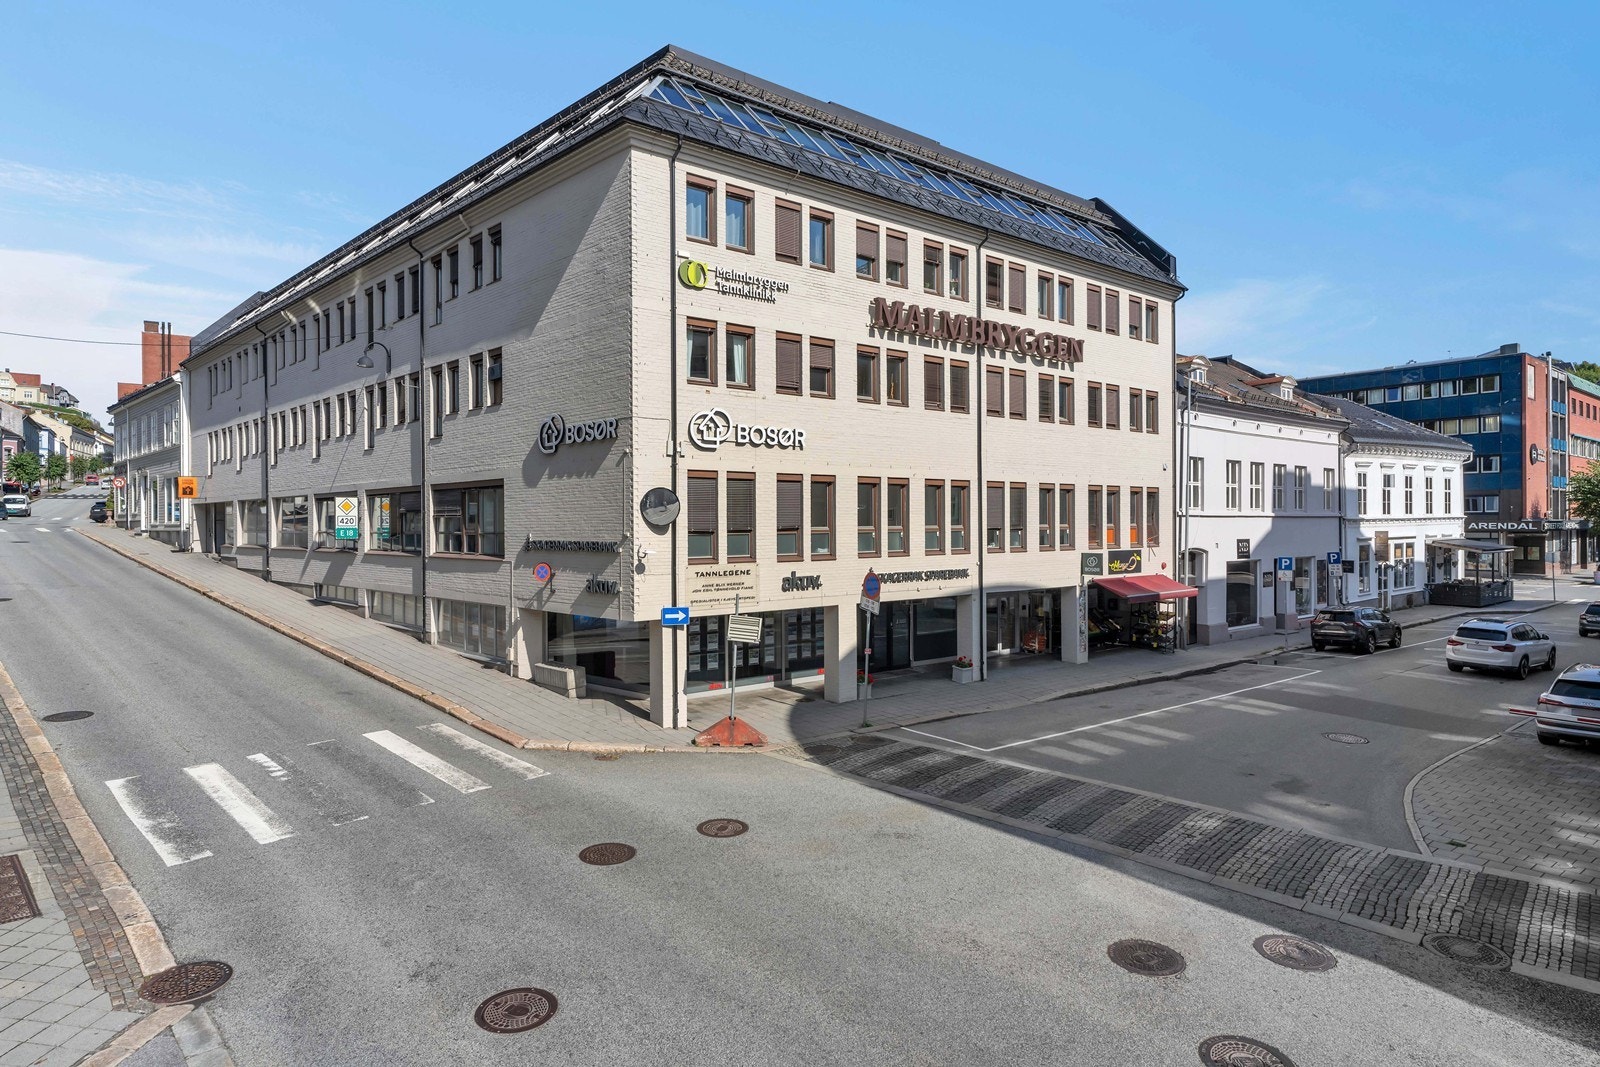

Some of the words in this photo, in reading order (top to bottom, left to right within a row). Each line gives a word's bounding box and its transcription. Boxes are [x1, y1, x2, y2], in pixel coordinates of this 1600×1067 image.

[715, 266, 789, 290] Malmbryggen
[717, 281, 777, 301] Tannklinikk
[873, 297, 1085, 362] MALMBRYGGEN
[565, 417, 617, 444] BOSØR
[737, 424, 806, 447] BOSØR
[1468, 522, 1537, 530] ARENDAL
[1281, 558, 1290, 569] P
[1330, 553, 1338, 563] P
[694, 569, 751, 577] TANNLEGENE
